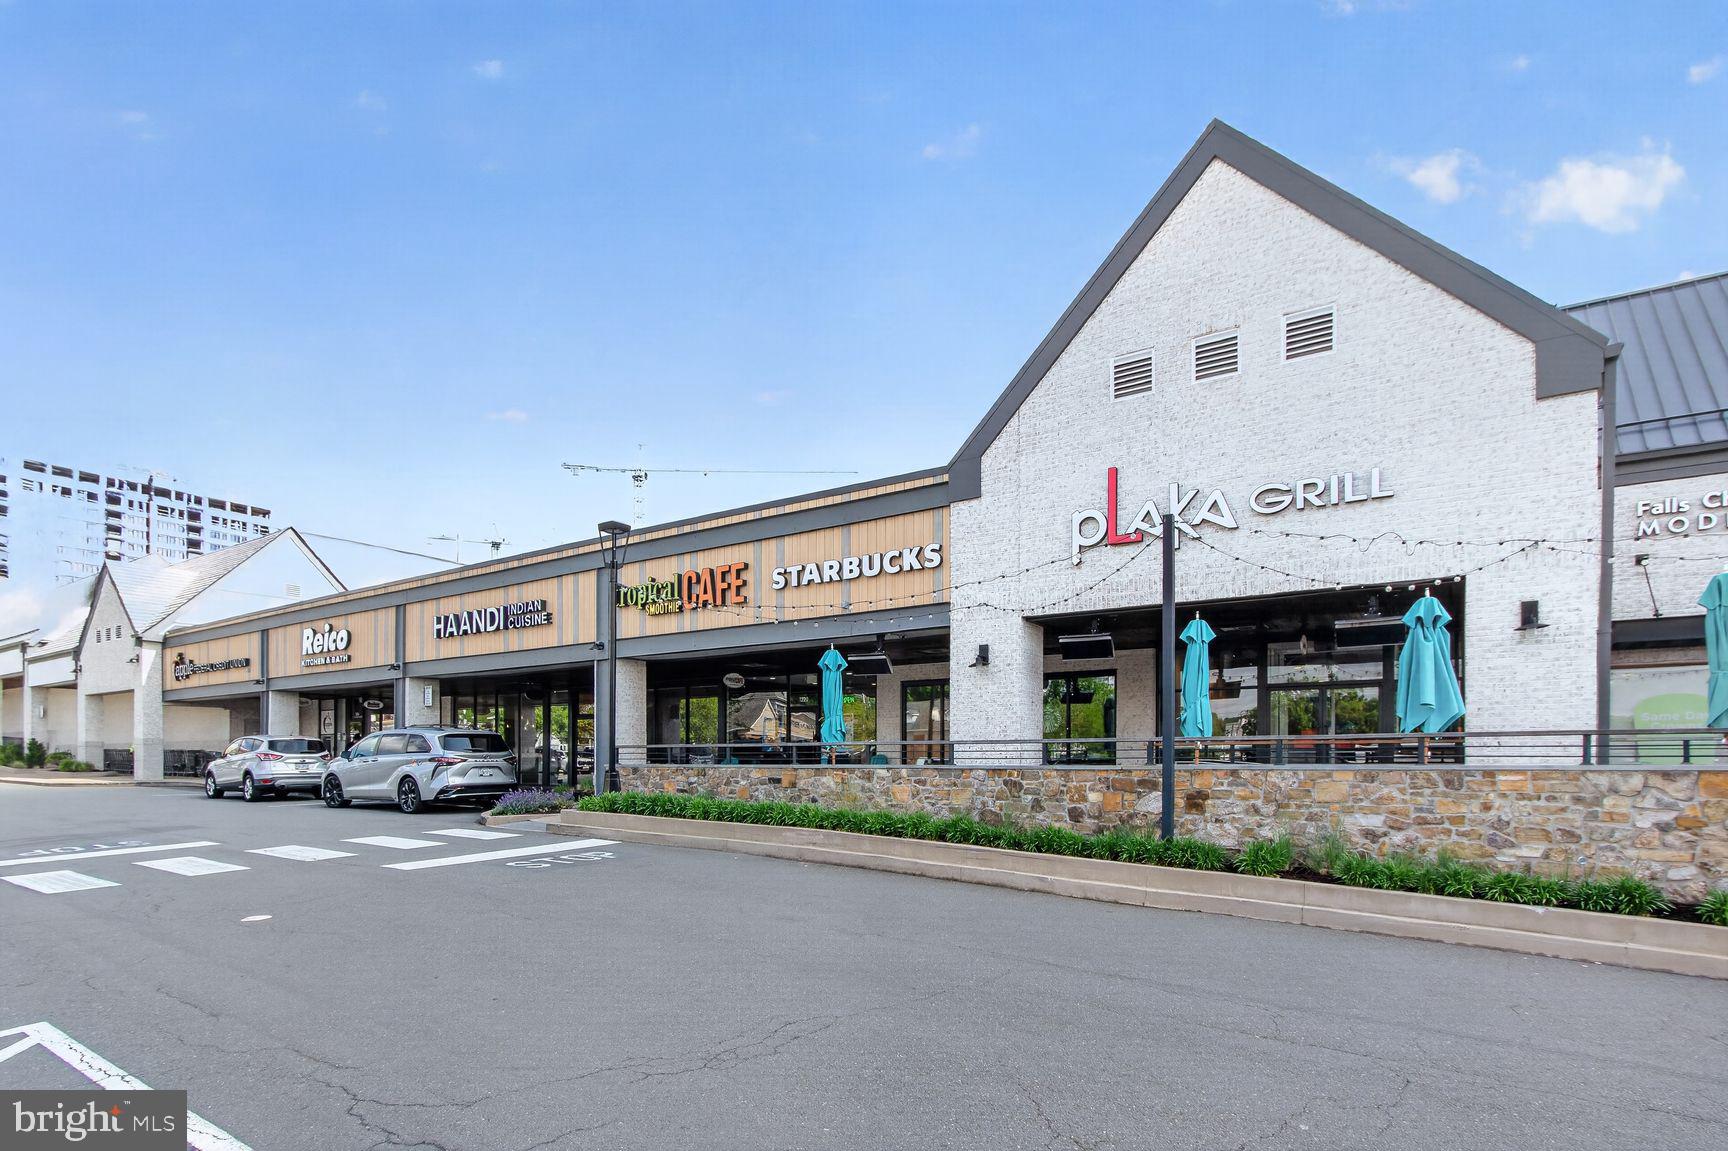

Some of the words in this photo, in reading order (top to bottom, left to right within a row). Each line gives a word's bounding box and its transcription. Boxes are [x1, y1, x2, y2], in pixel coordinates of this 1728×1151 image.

[1248, 468, 1394, 515] GRILL
[1637, 497, 1690, 517] Falls
[1637, 513, 1728, 537] MOD
[771, 543, 943, 590] STARBUCKS
[682, 562, 748, 610] CAFE
[507, 599, 545, 616] INDIAN
[645, 601, 681, 616] SMOOTHIE
[433, 605, 507, 639] HAANDI
[507, 612, 552, 629] CUISINE
[302, 623, 352, 655] Reico
[331, 654, 351, 663] BATH
[1640, 712, 1680, 721] Same
[505, 851, 616, 869] STOP
